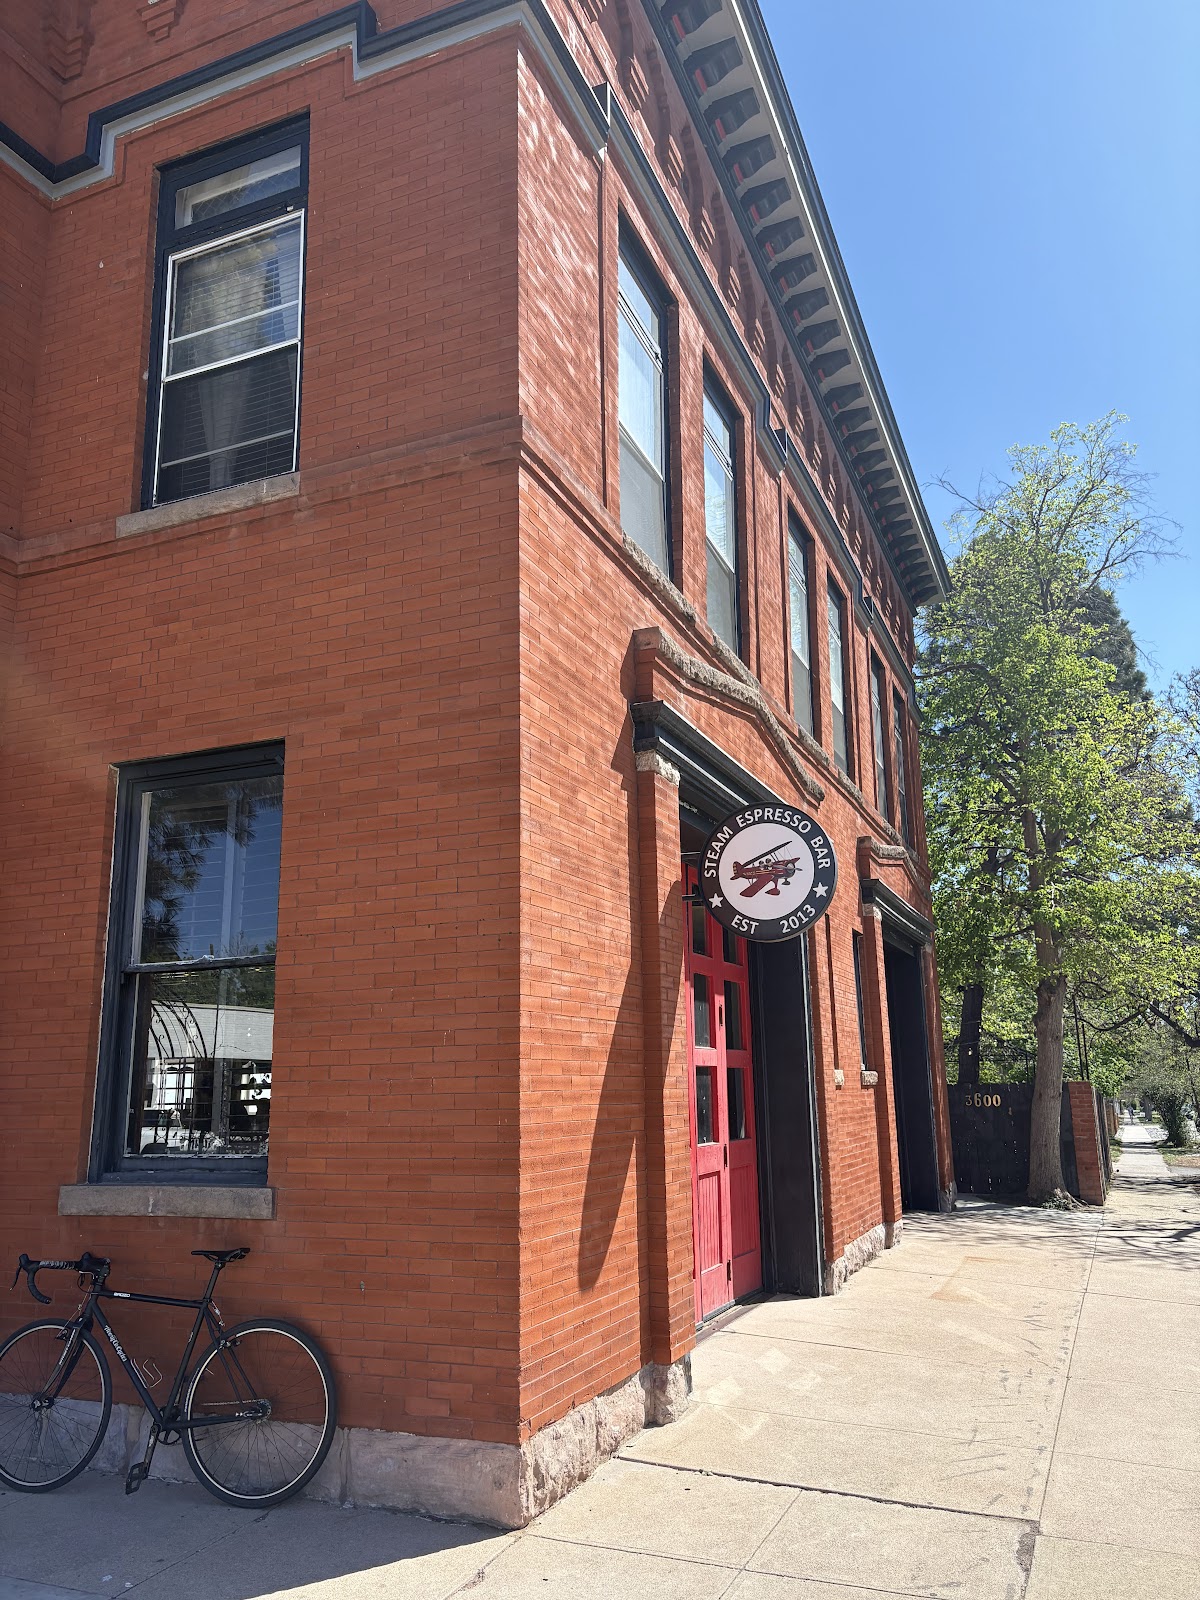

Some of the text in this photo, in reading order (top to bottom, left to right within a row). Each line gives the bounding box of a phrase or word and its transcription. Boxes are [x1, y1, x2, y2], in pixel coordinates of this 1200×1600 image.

[704, 807, 831, 878] STEAM ESPRESSO BAR
[731, 904, 816, 935] EST 2013
[965, 1092, 1002, 1107] 3600
